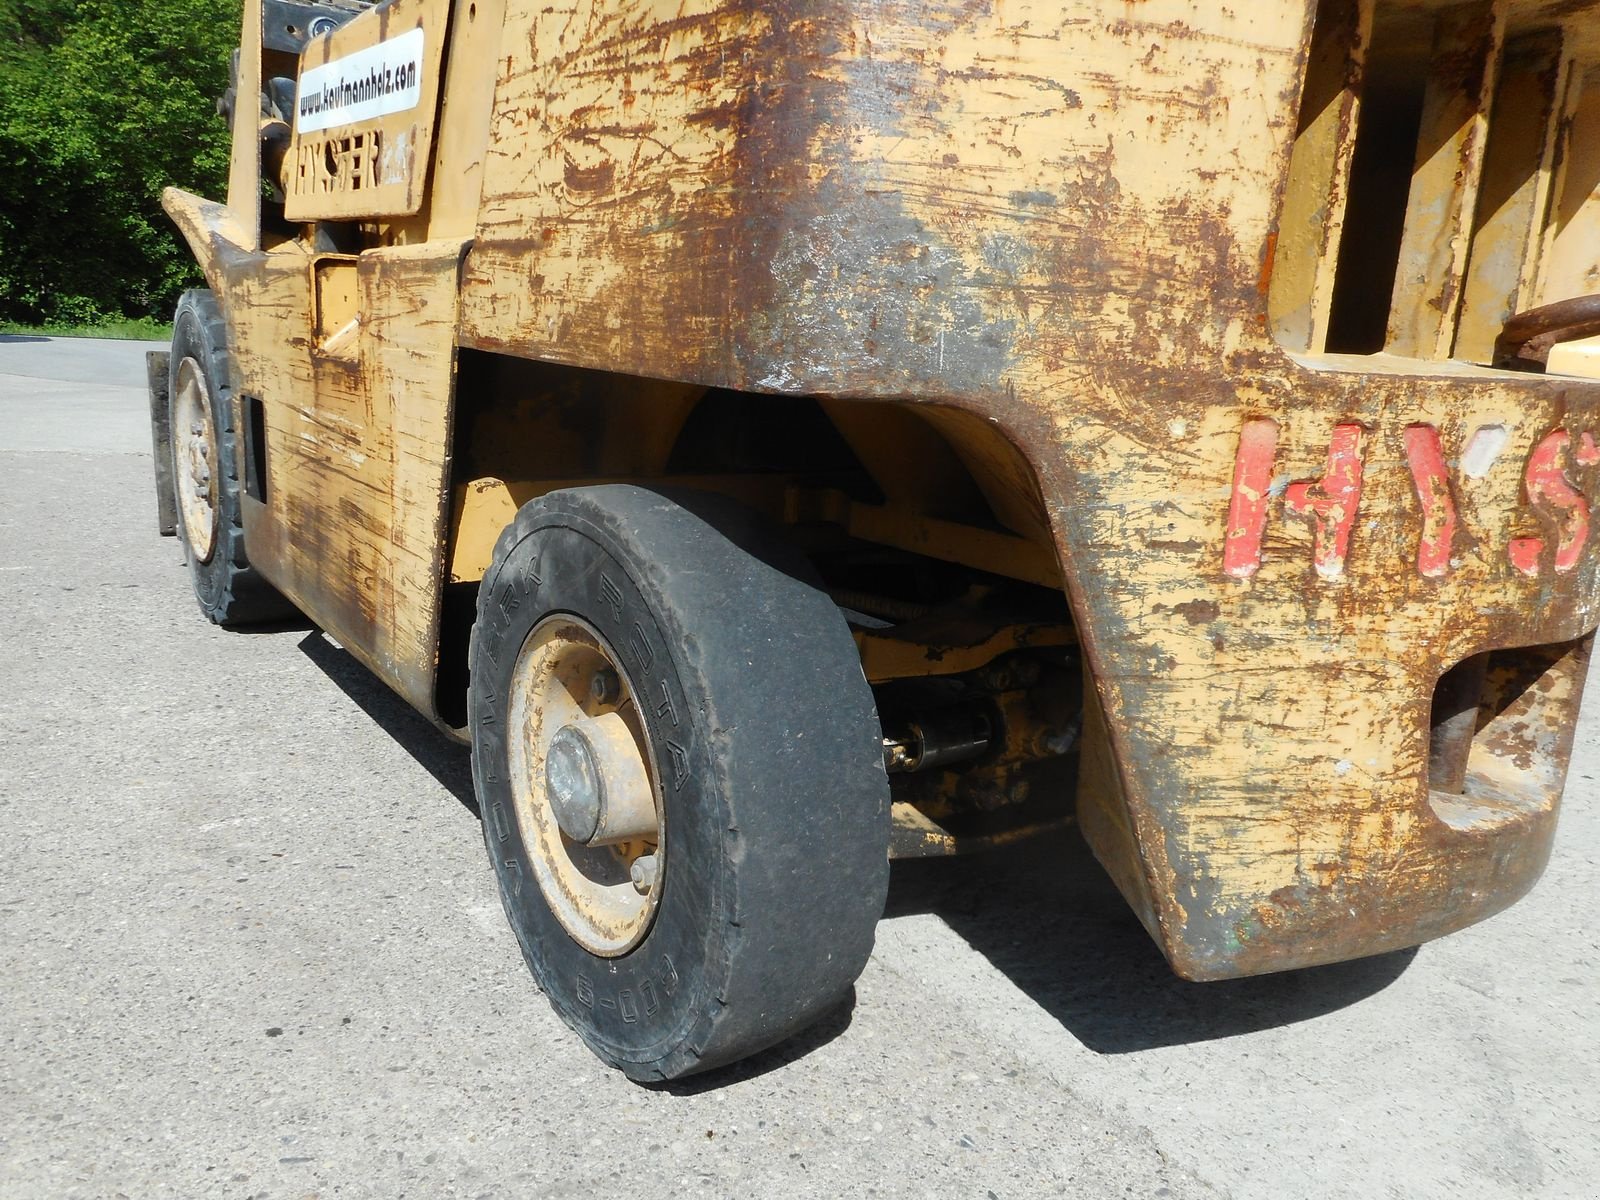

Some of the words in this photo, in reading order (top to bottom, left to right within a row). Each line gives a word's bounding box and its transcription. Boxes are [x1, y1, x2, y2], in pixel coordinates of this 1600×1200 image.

[300, 60, 416, 117] www.kaufmannholz.com
[294, 129, 383, 195] HYSTER
[600, 571, 691, 793] ROTA
